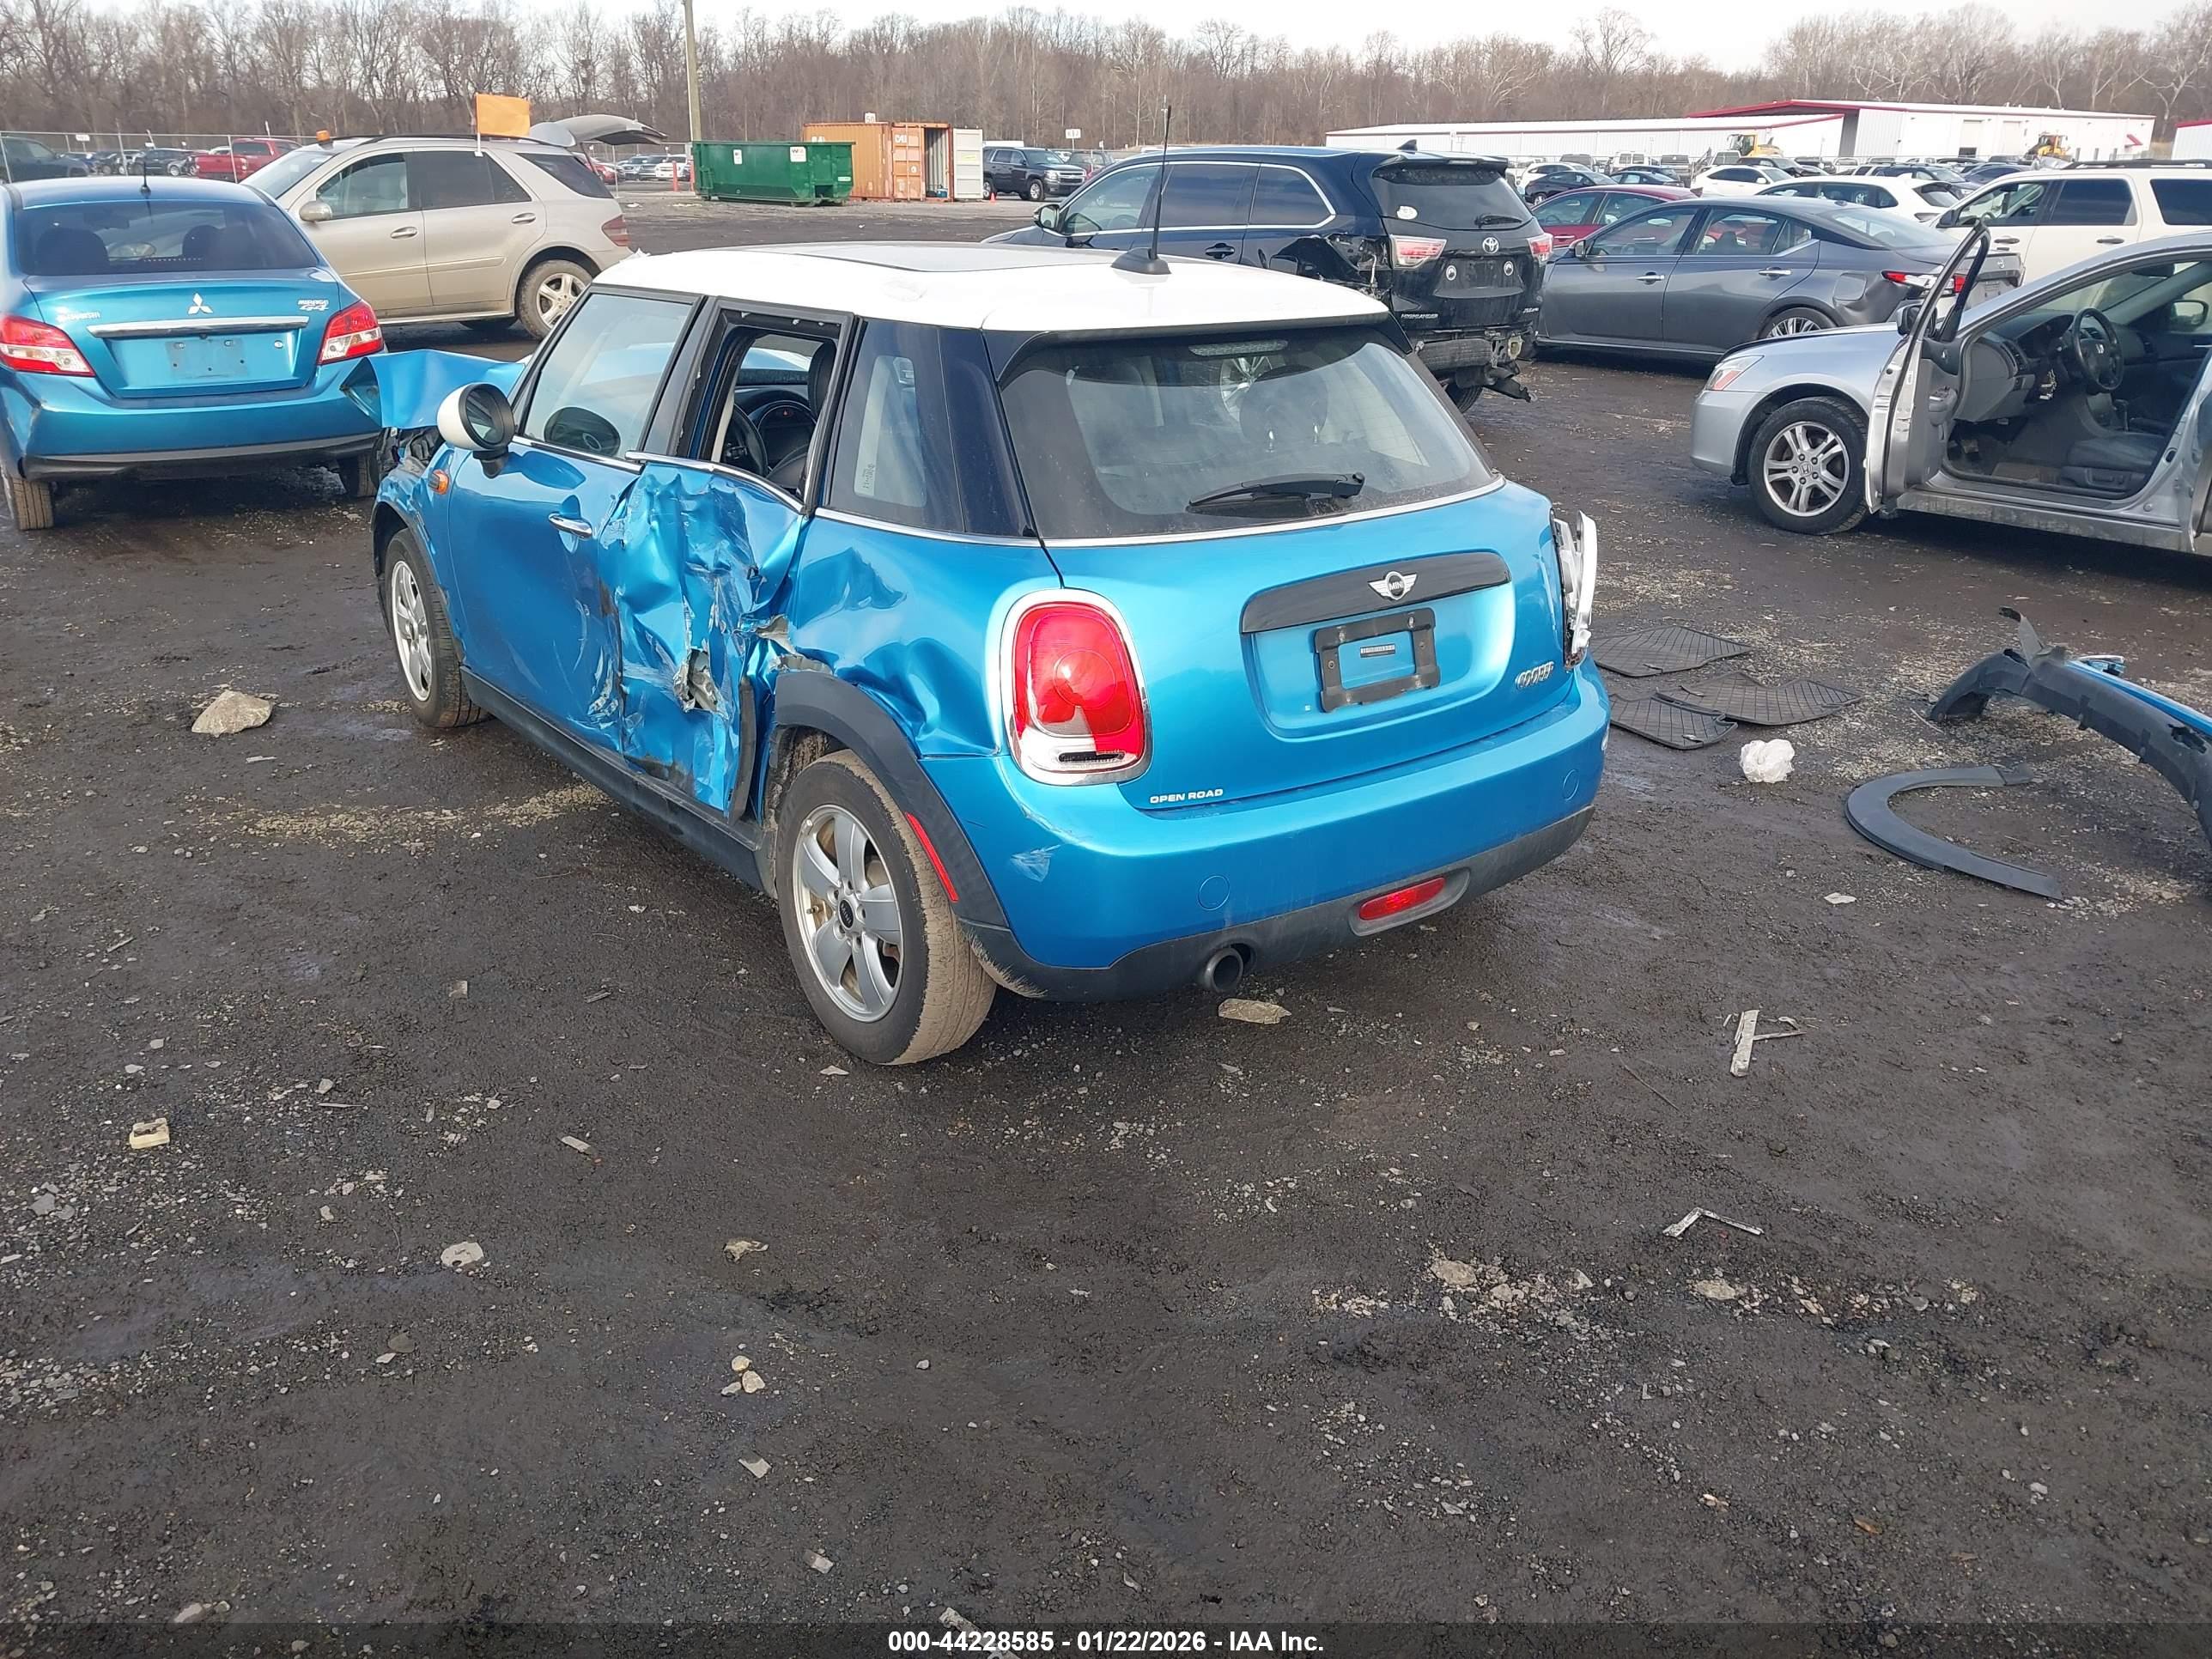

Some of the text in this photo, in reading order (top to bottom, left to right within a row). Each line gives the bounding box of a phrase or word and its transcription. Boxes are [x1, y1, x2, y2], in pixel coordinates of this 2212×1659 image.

[1389, 580, 1404, 591] MINI
[1150, 788, 1224, 804] OPEN ROAD
